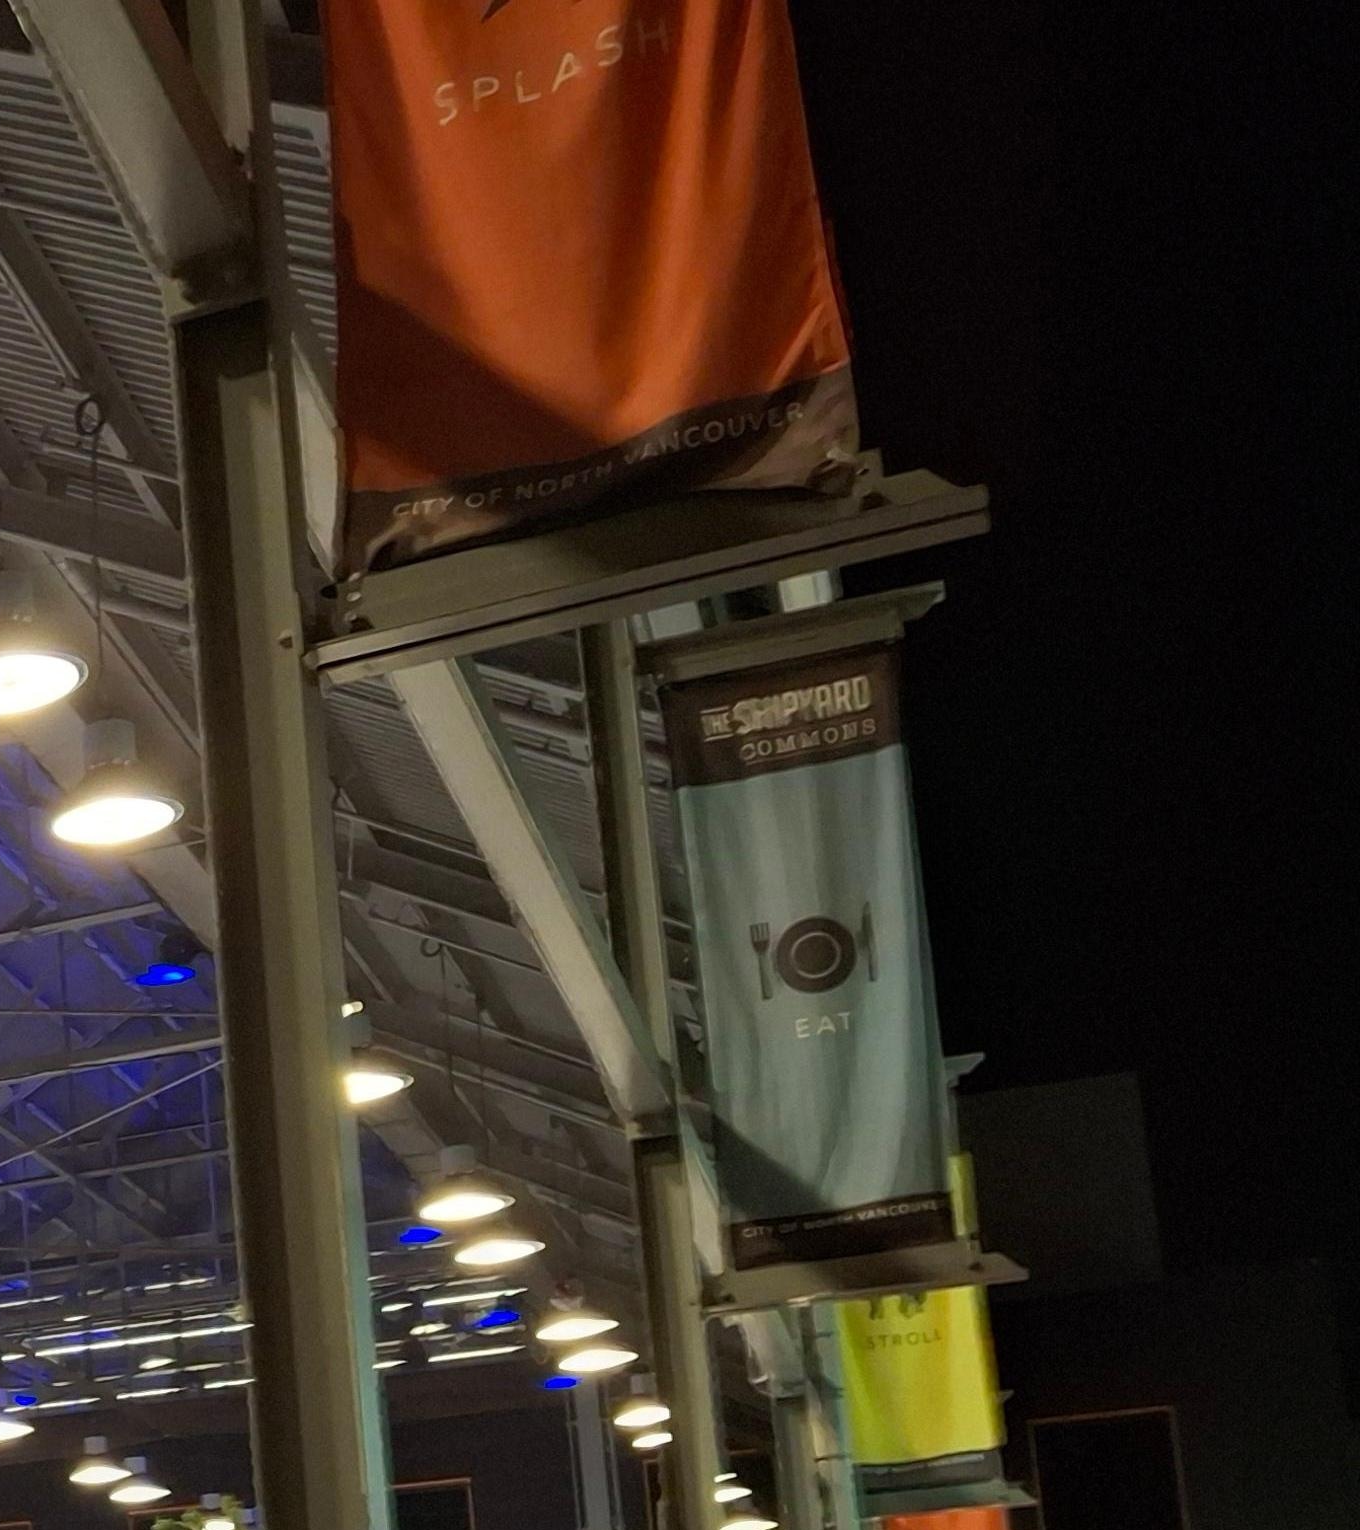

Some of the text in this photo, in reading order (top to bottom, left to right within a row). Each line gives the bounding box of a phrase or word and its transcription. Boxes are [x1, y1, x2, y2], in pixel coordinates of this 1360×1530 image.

[434, 18, 670, 126] SPLASH
[392, 402, 806, 518] CITY OF NORTH VANCOUVER
[732, 675, 872, 735] SHIPYARD
[739, 718, 877, 761] COMMONS
[794, 1011, 851, 1039] EAT
[866, 1327, 942, 1351] STROLL
